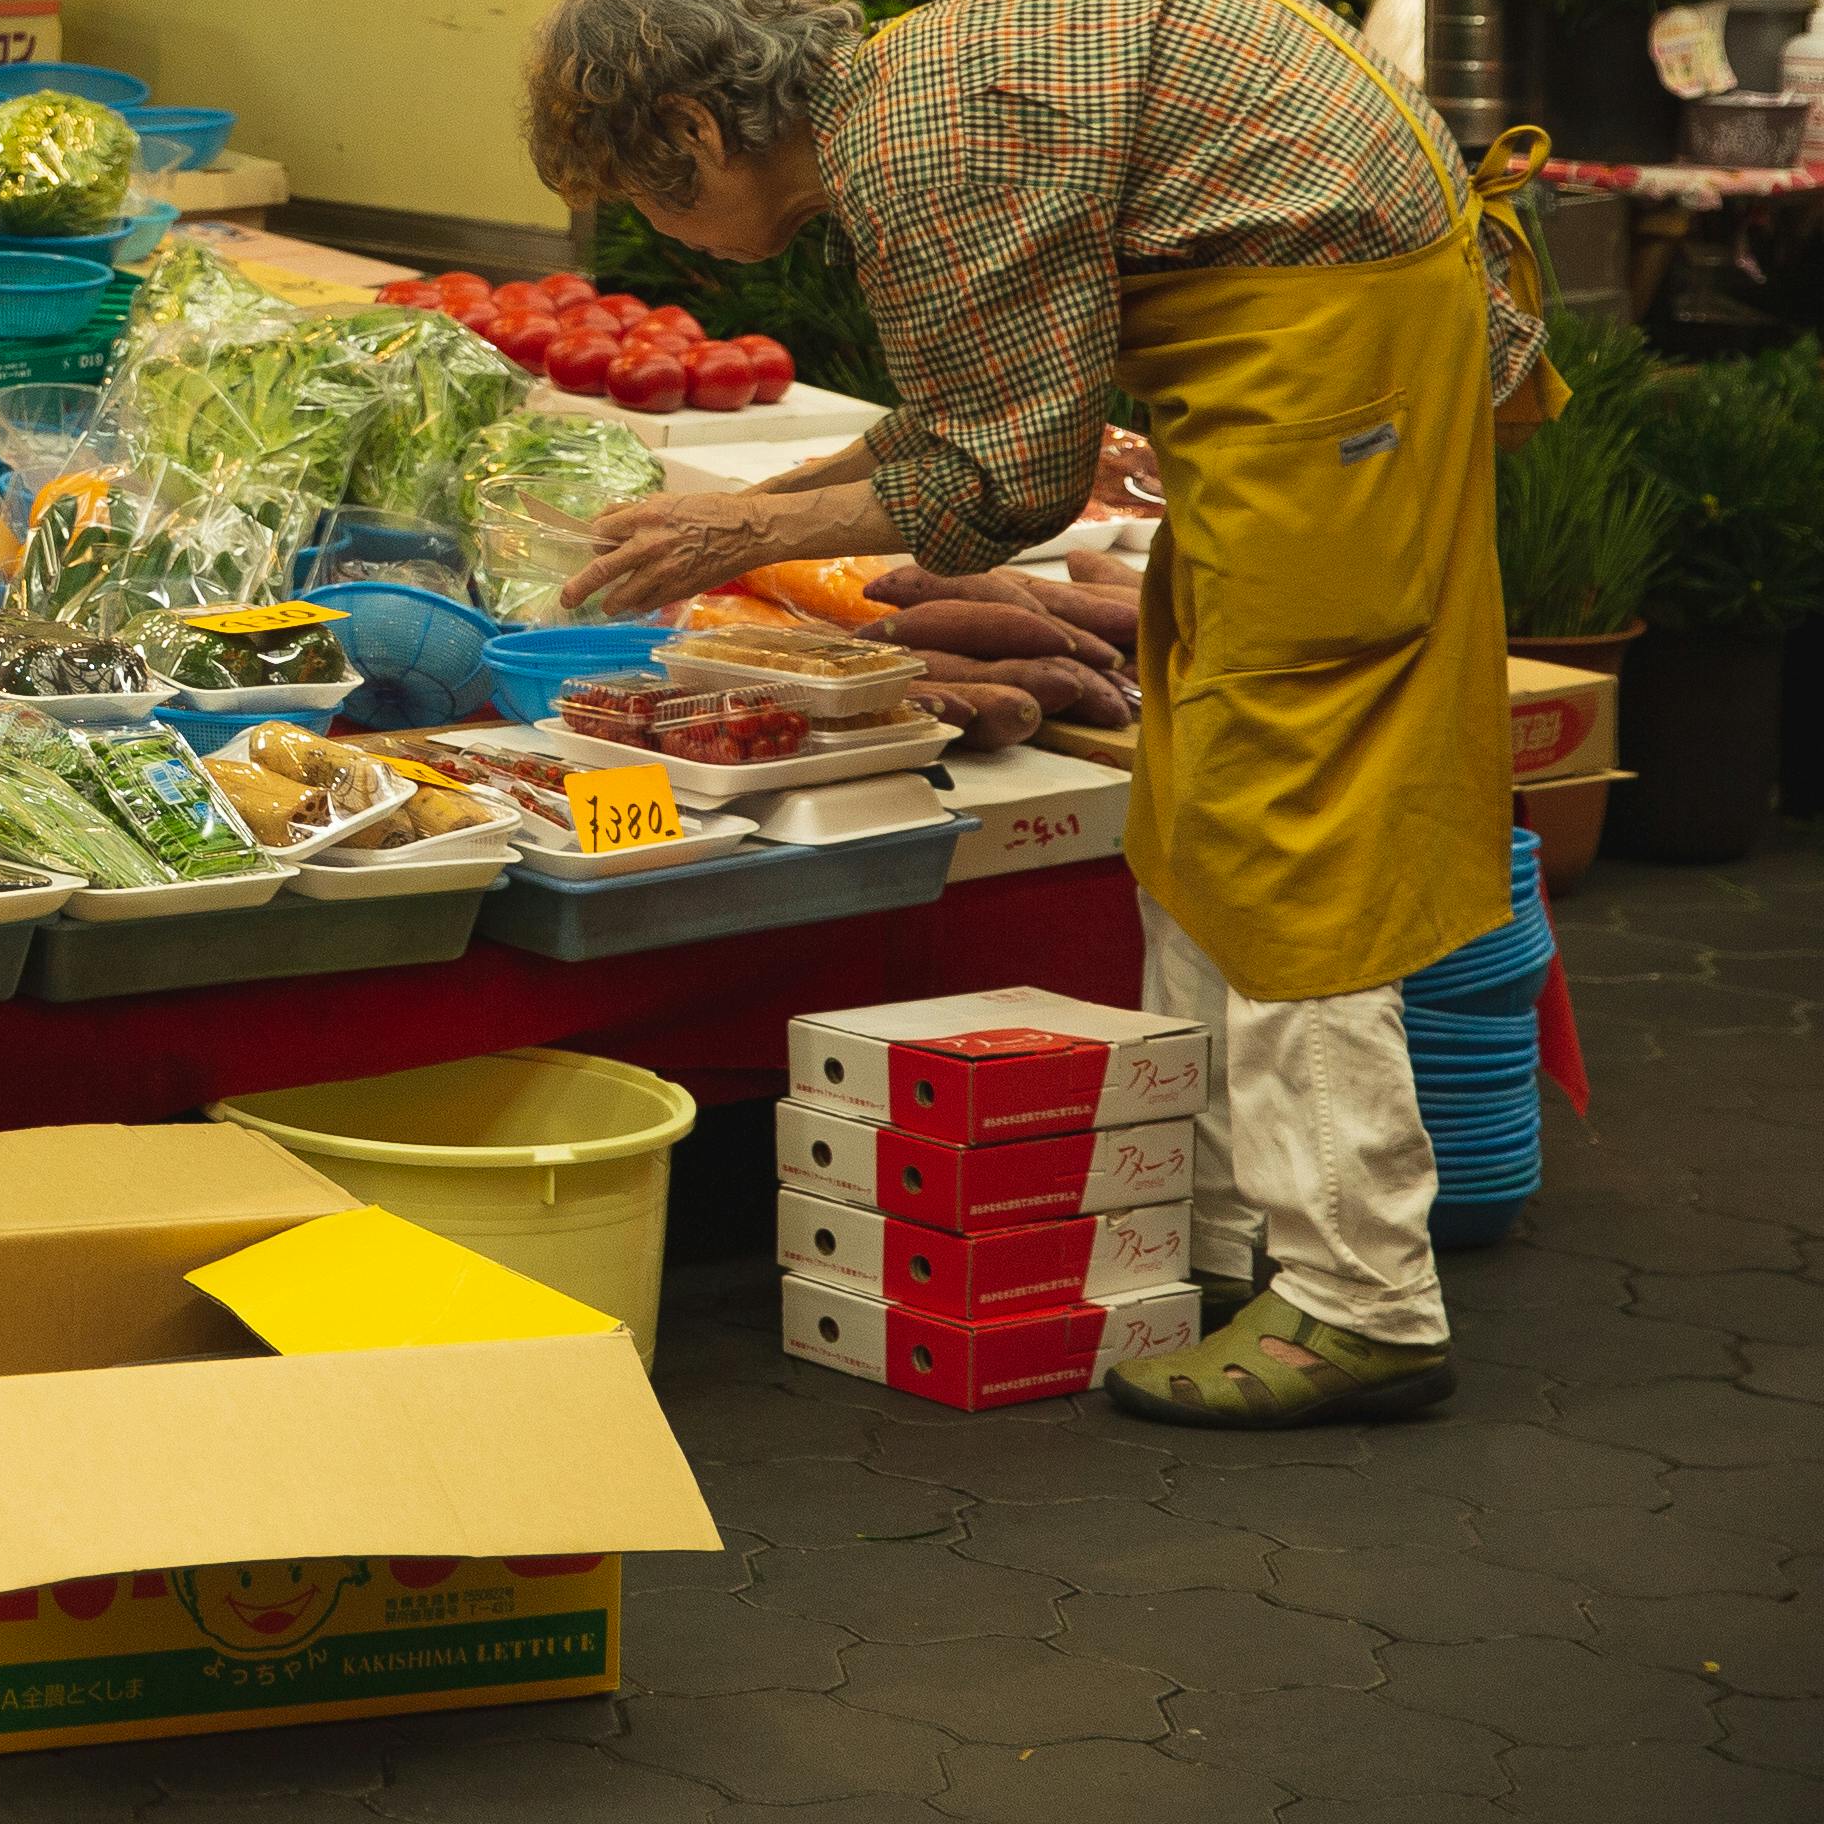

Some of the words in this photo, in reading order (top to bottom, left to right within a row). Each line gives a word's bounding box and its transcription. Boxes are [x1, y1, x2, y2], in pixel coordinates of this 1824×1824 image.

[1003, 813, 1080, 851] いちご
[1126, 1059, 1200, 1100] アメーラ
[1113, 1146, 1185, 1183] アメーラ
[1111, 1228, 1181, 1266] アメーラ
[1121, 1320, 1192, 1357] アメーラ
[202, 1648, 331, 1687] よっちゃん
[342, 1646, 470, 1676] KAKISHIMA
[475, 1631, 599, 1664] LETTUCE
